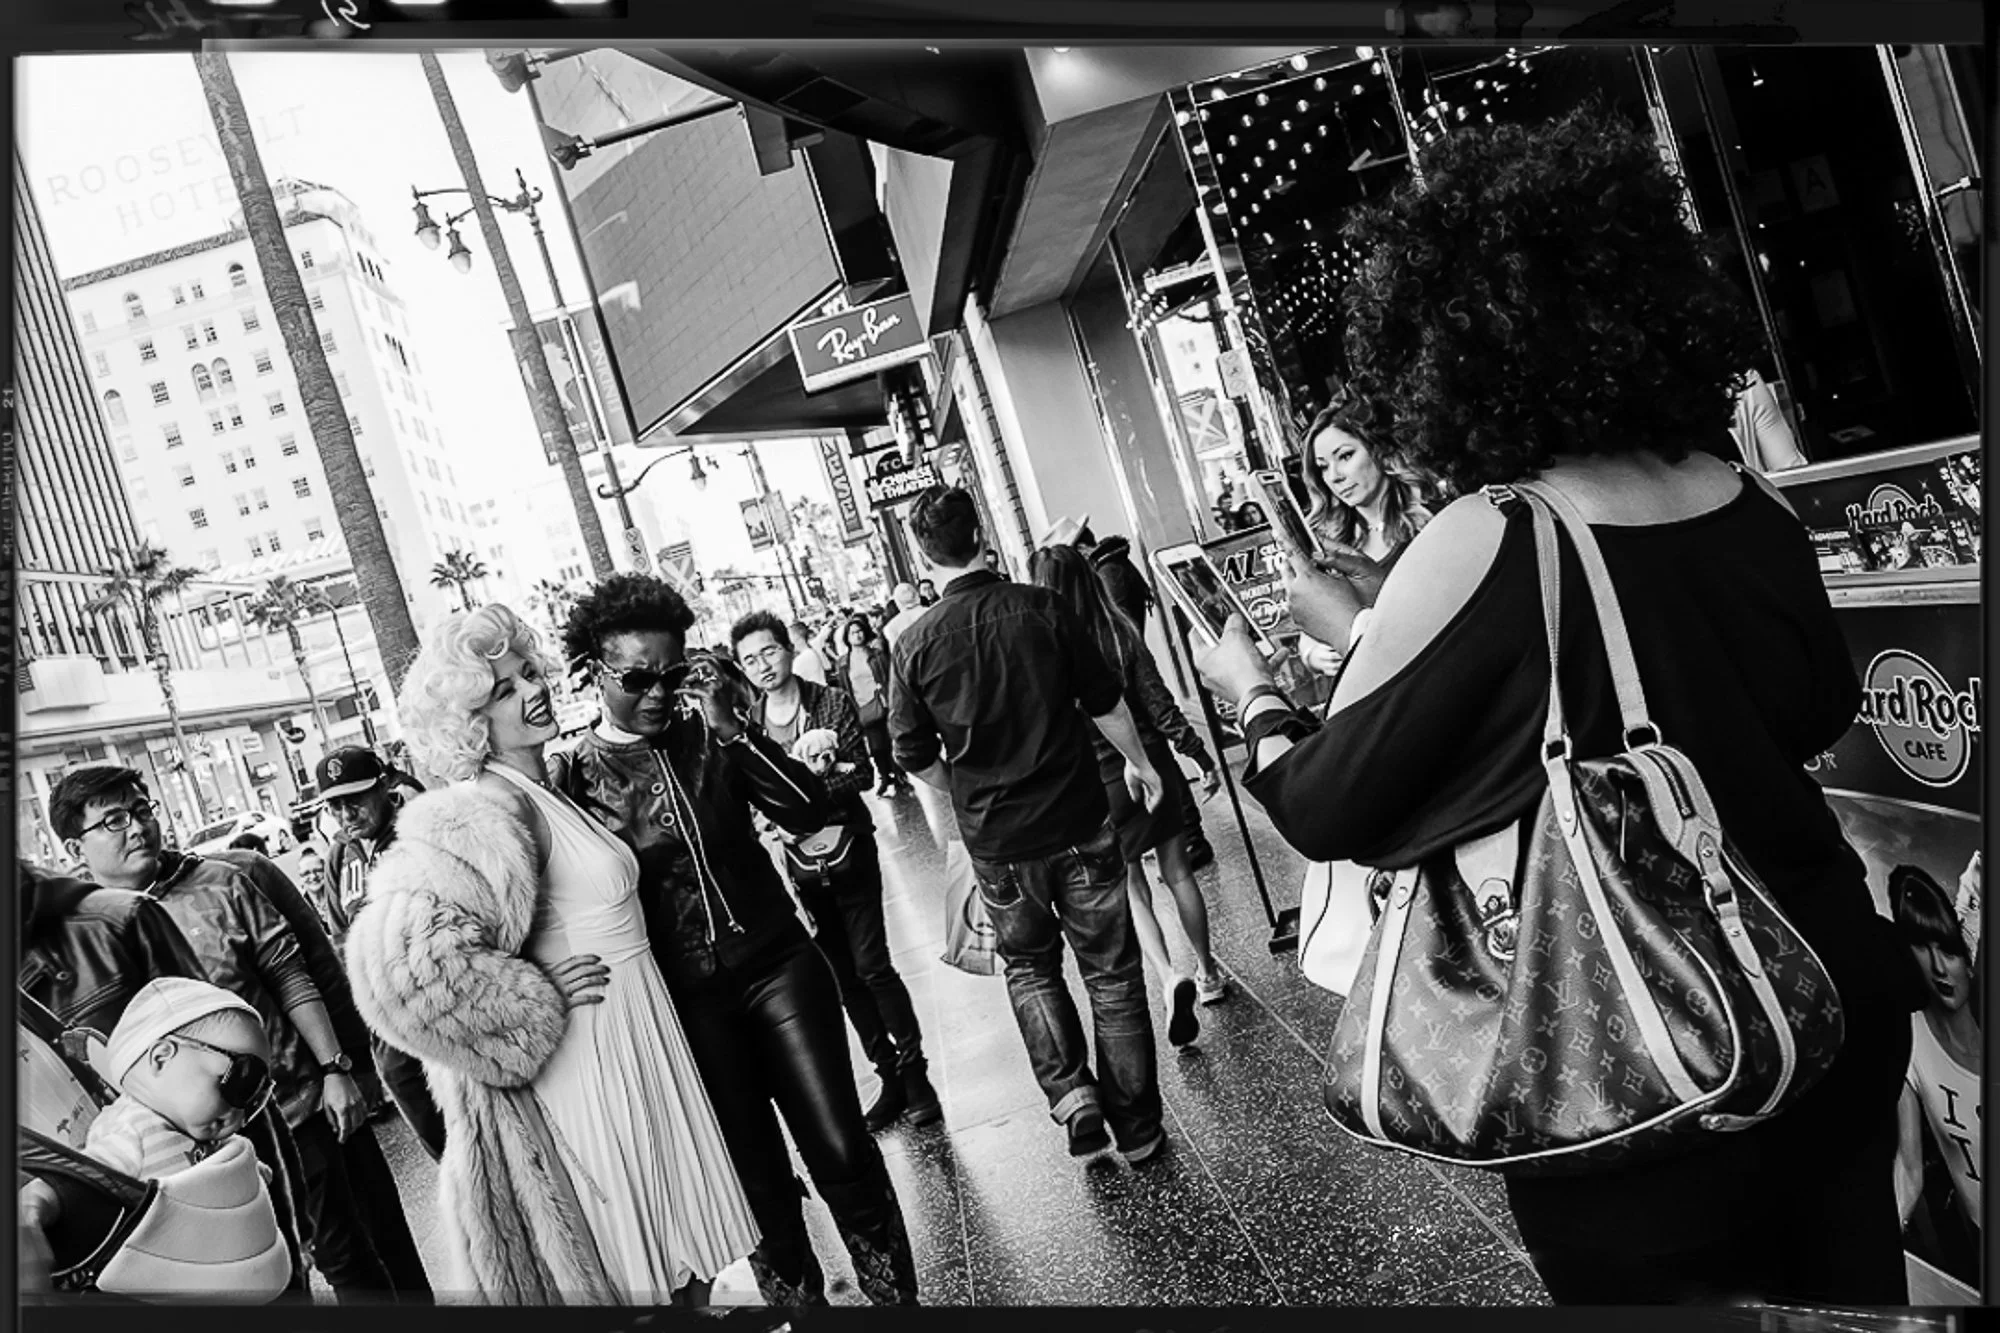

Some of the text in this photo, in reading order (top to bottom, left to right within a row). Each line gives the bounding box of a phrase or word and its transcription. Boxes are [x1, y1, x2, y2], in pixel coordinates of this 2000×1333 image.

[46, 104, 306, 207] ROOSEVLT
[115, 174, 241, 237] HOTE
[817, 307, 901, 364] Ray-Ban
[1846, 500, 1897, 534] Hard
[1854, 675, 1911, 728] ard
[1904, 740, 1948, 761] CAFE
